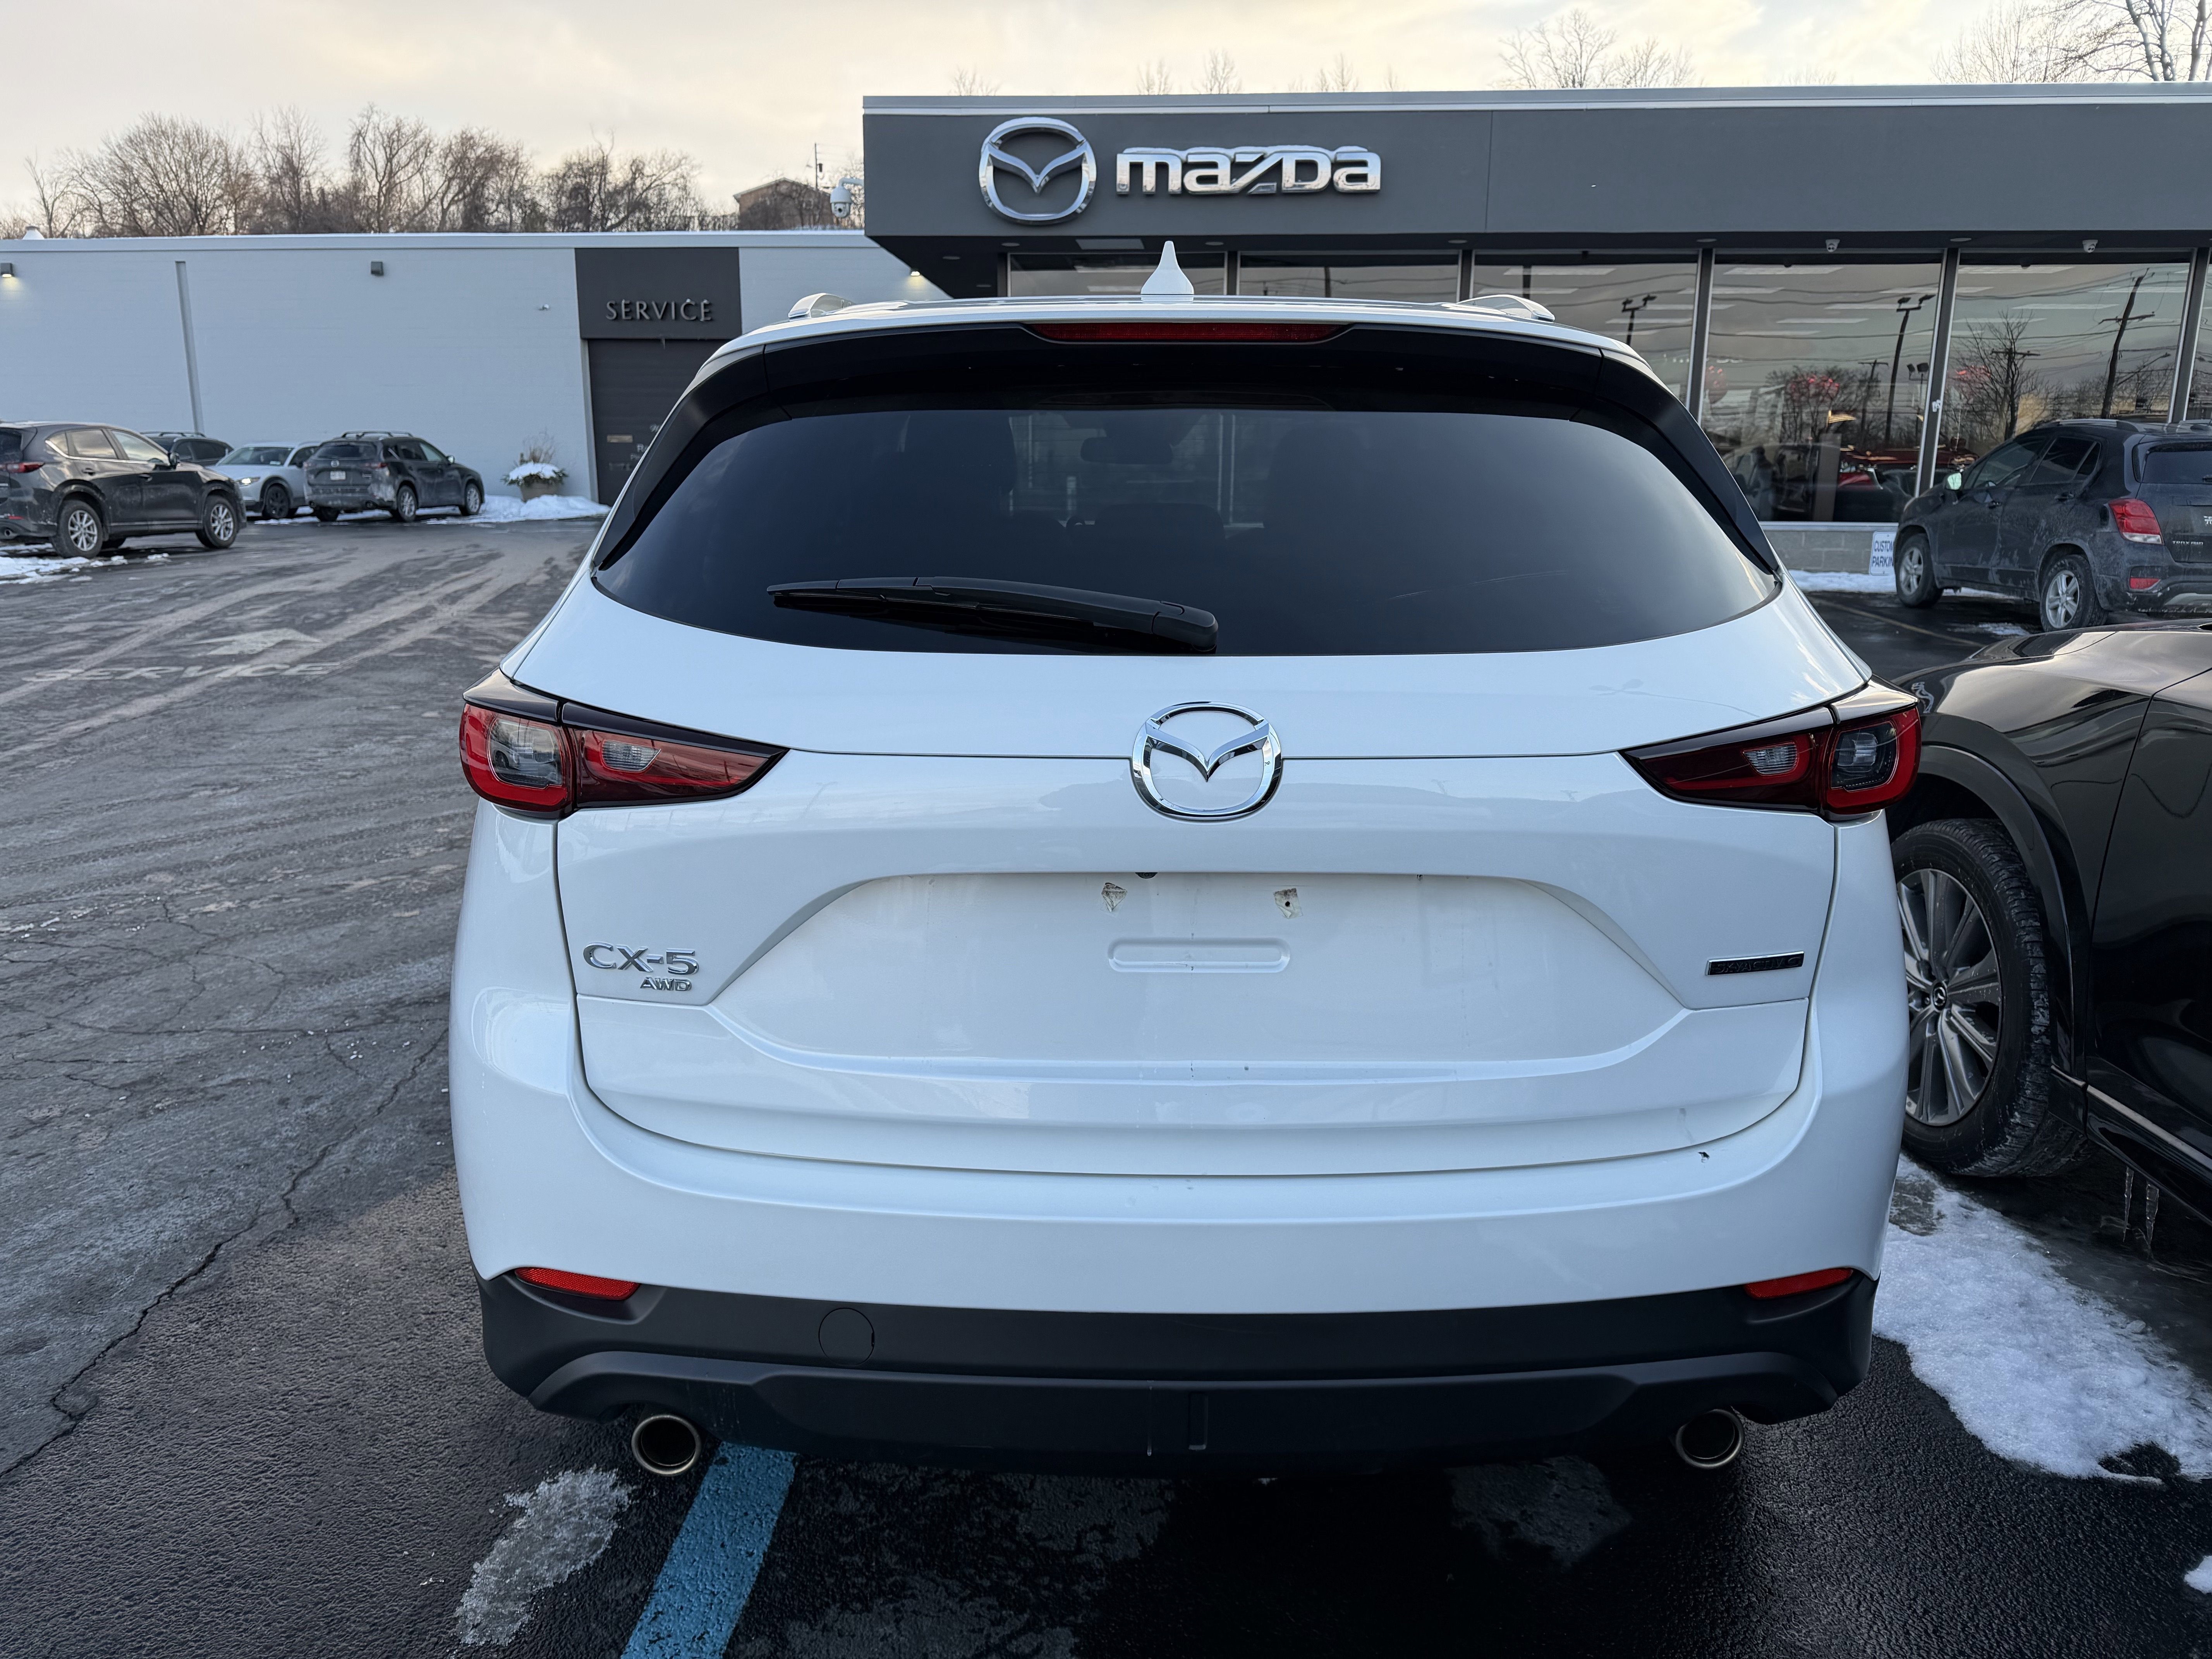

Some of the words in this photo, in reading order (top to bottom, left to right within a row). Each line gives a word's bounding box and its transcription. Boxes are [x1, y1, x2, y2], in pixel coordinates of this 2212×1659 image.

[1116, 146, 1381, 195] mazda
[605, 299, 712, 321] SERVICE
[583, 941, 700, 975] CX-5
[1715, 958, 1784, 974] SKYACTIV
[640, 976, 692, 991] AWD
